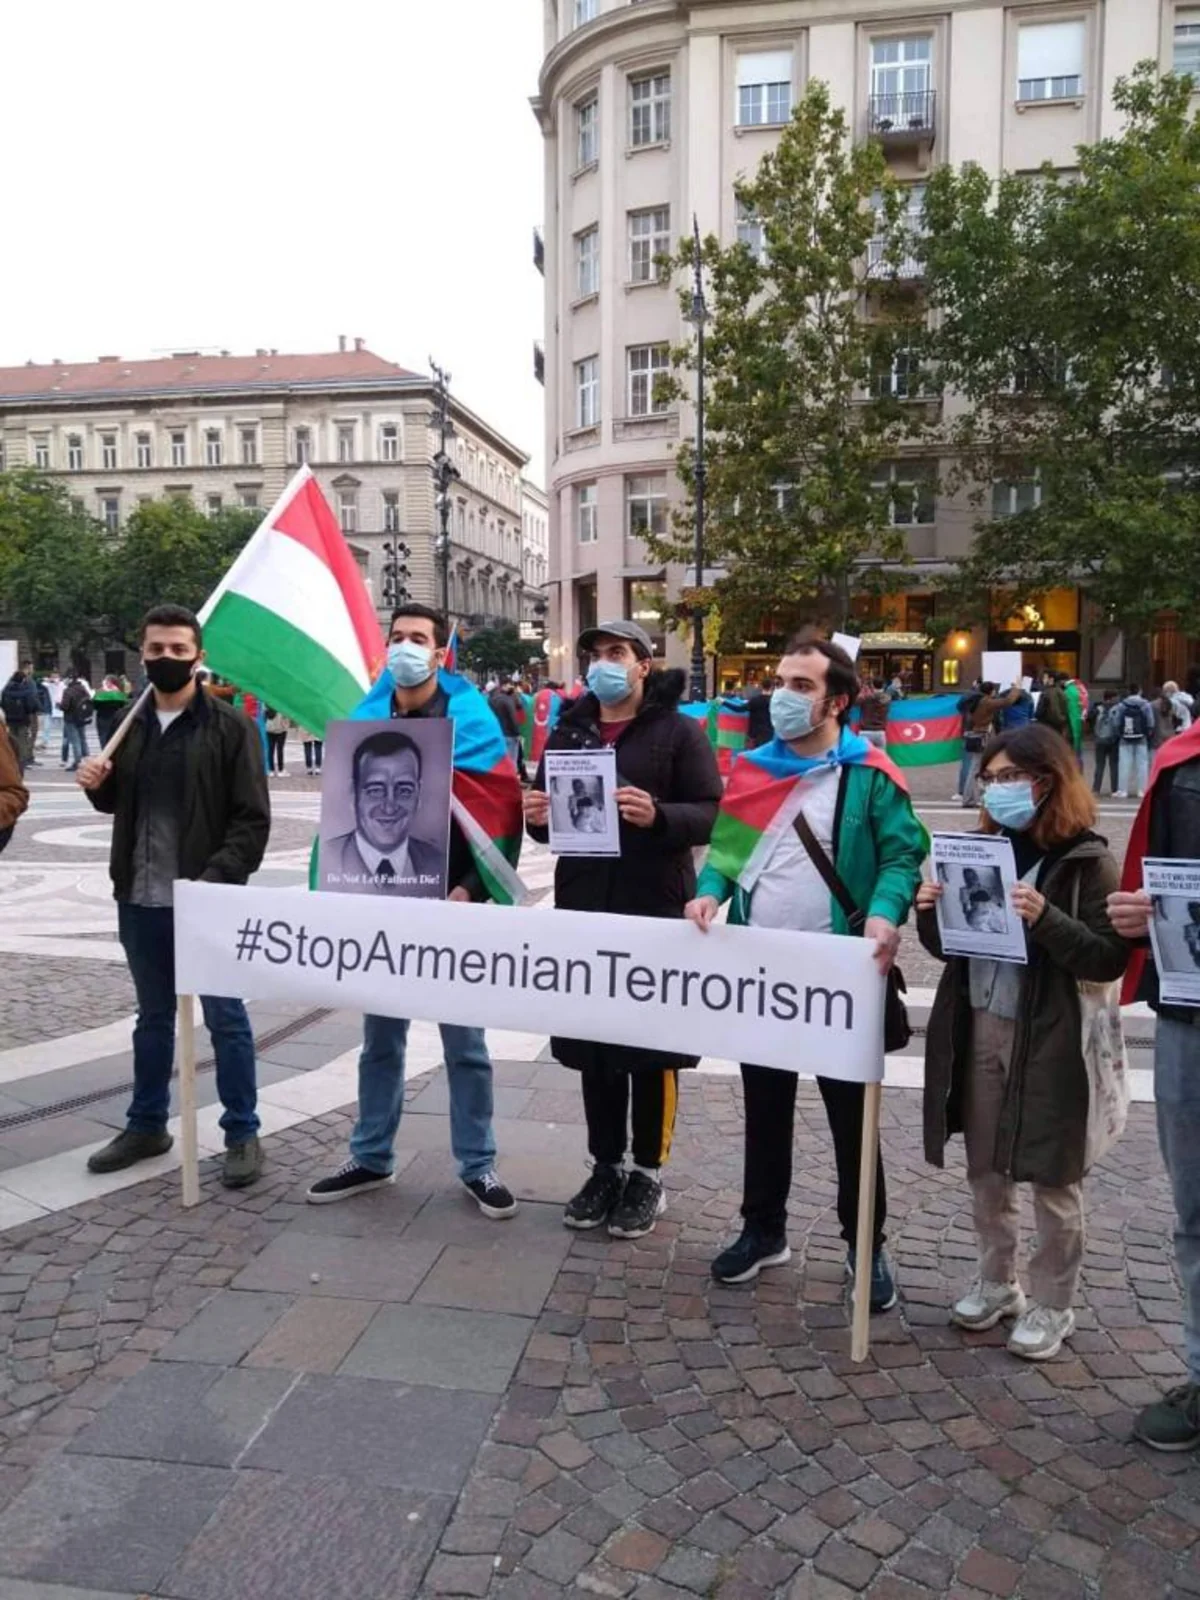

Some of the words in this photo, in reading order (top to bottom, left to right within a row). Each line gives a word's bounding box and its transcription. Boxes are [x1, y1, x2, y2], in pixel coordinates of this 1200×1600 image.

[327, 873, 341, 883] Do
[343, 873, 360, 884] Not
[362, 873, 379, 885] Let
[381, 873, 418, 885] Fathers
[419, 873, 440, 885] Die!
[235, 917, 855, 1030] #StopArmenianTerrorism
